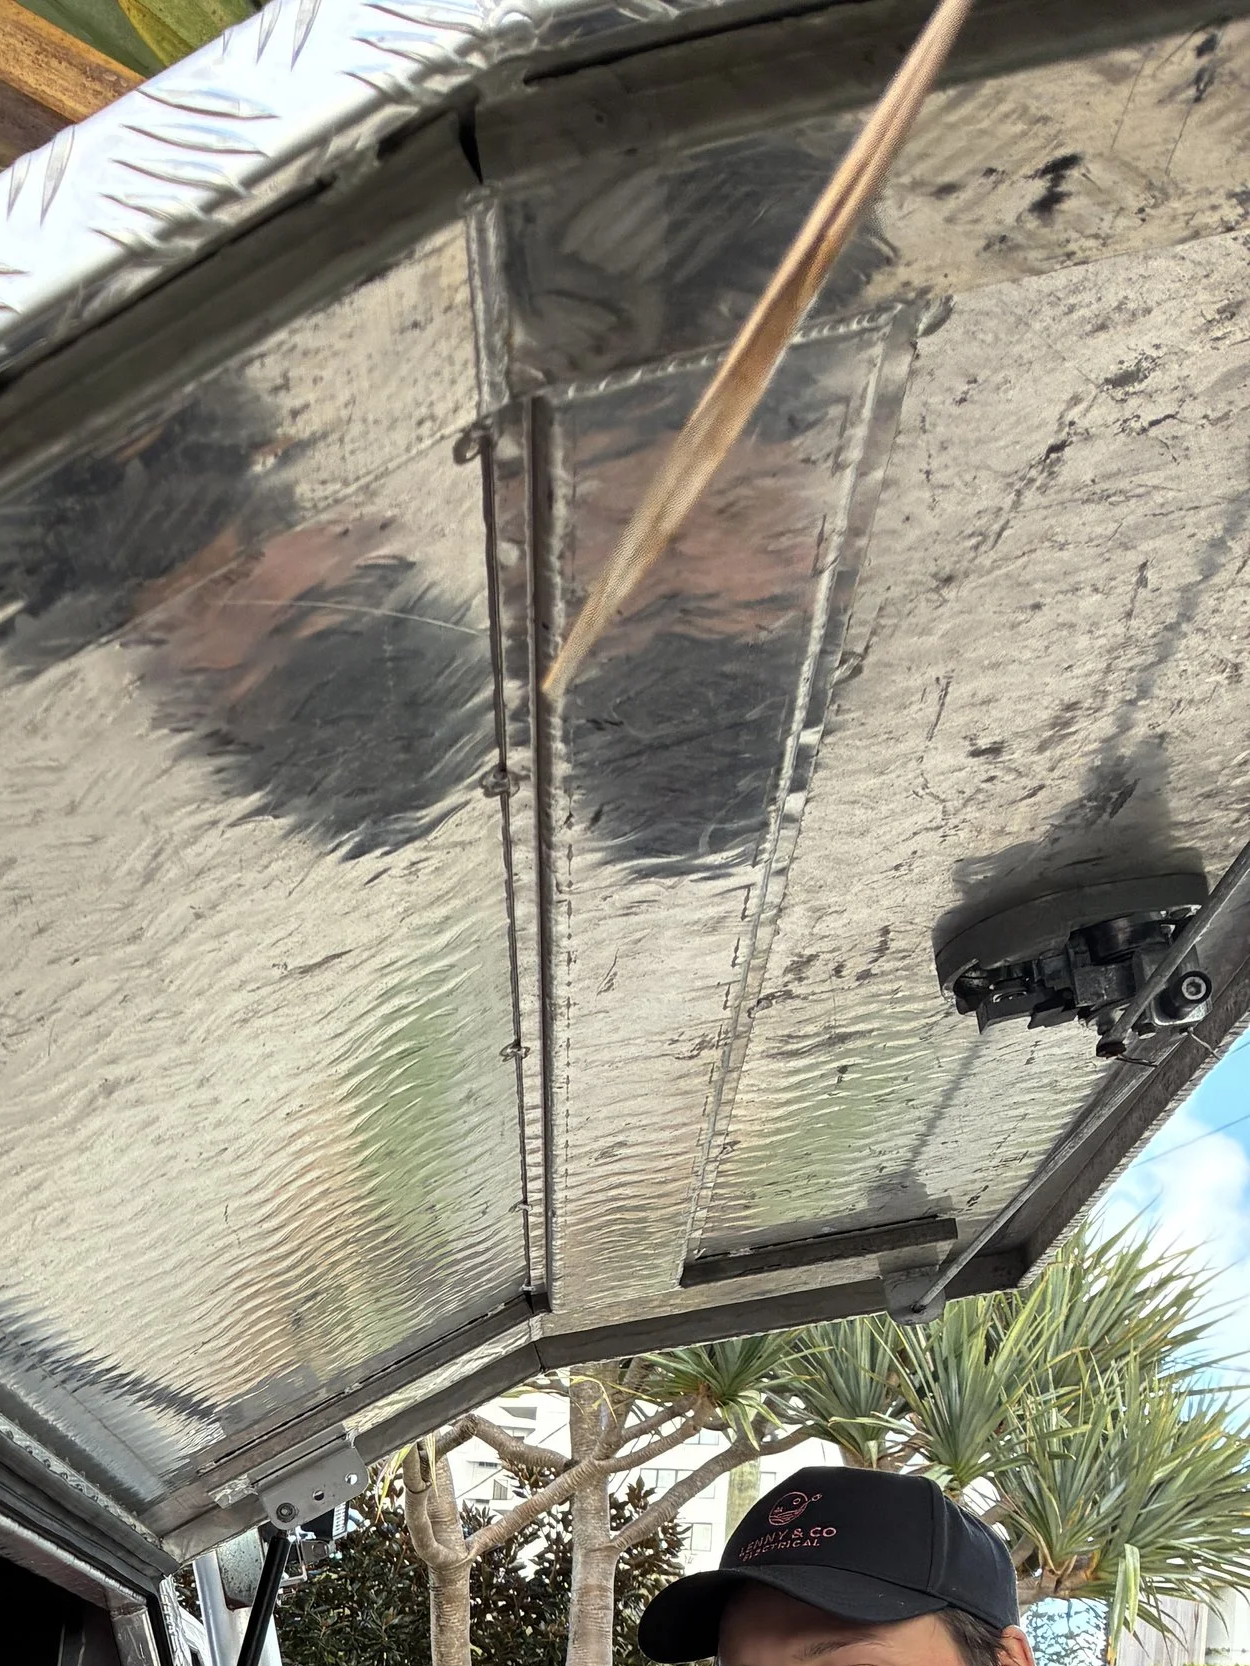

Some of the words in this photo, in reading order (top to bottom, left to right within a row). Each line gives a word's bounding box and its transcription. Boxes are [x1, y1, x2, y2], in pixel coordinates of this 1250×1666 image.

[738, 1528, 789, 1558] LENNY
[791, 1527, 804, 1539] &
[810, 1526, 837, 1538] CO
[742, 1538, 821, 1562] ELECTRICAL
